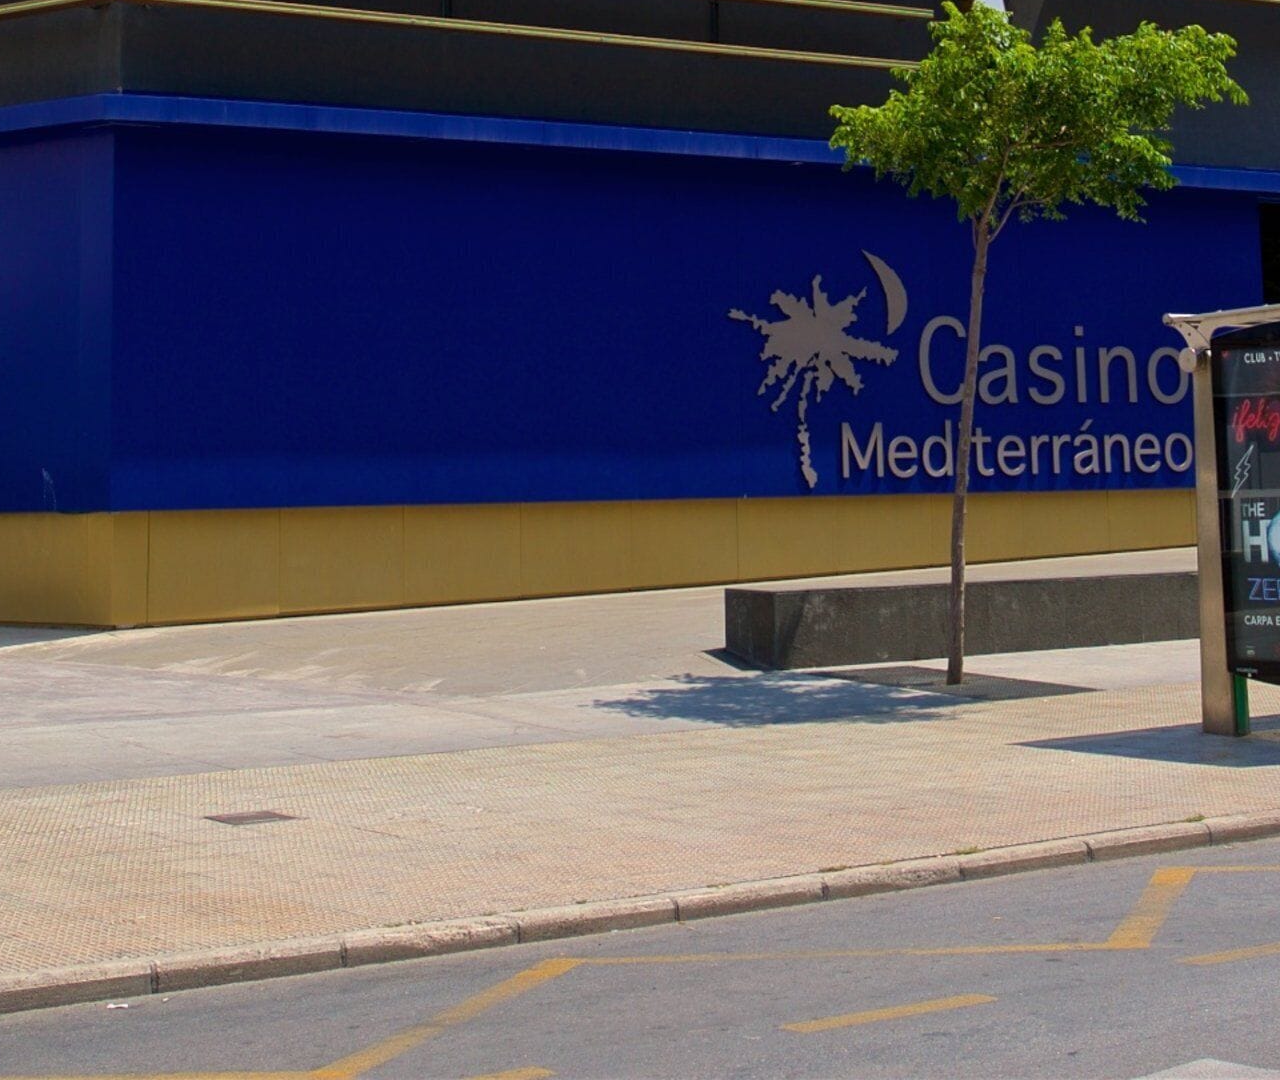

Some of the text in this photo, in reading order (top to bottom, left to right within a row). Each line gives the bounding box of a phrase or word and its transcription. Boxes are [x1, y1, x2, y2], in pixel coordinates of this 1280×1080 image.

[919, 314, 1190, 406] Casino
[1244, 352, 1266, 364] CLUB
[842, 418, 1193, 479] Medterráneo
[1242, 502, 1265, 517] THE
[1244, 615, 1273, 626] CARPA
